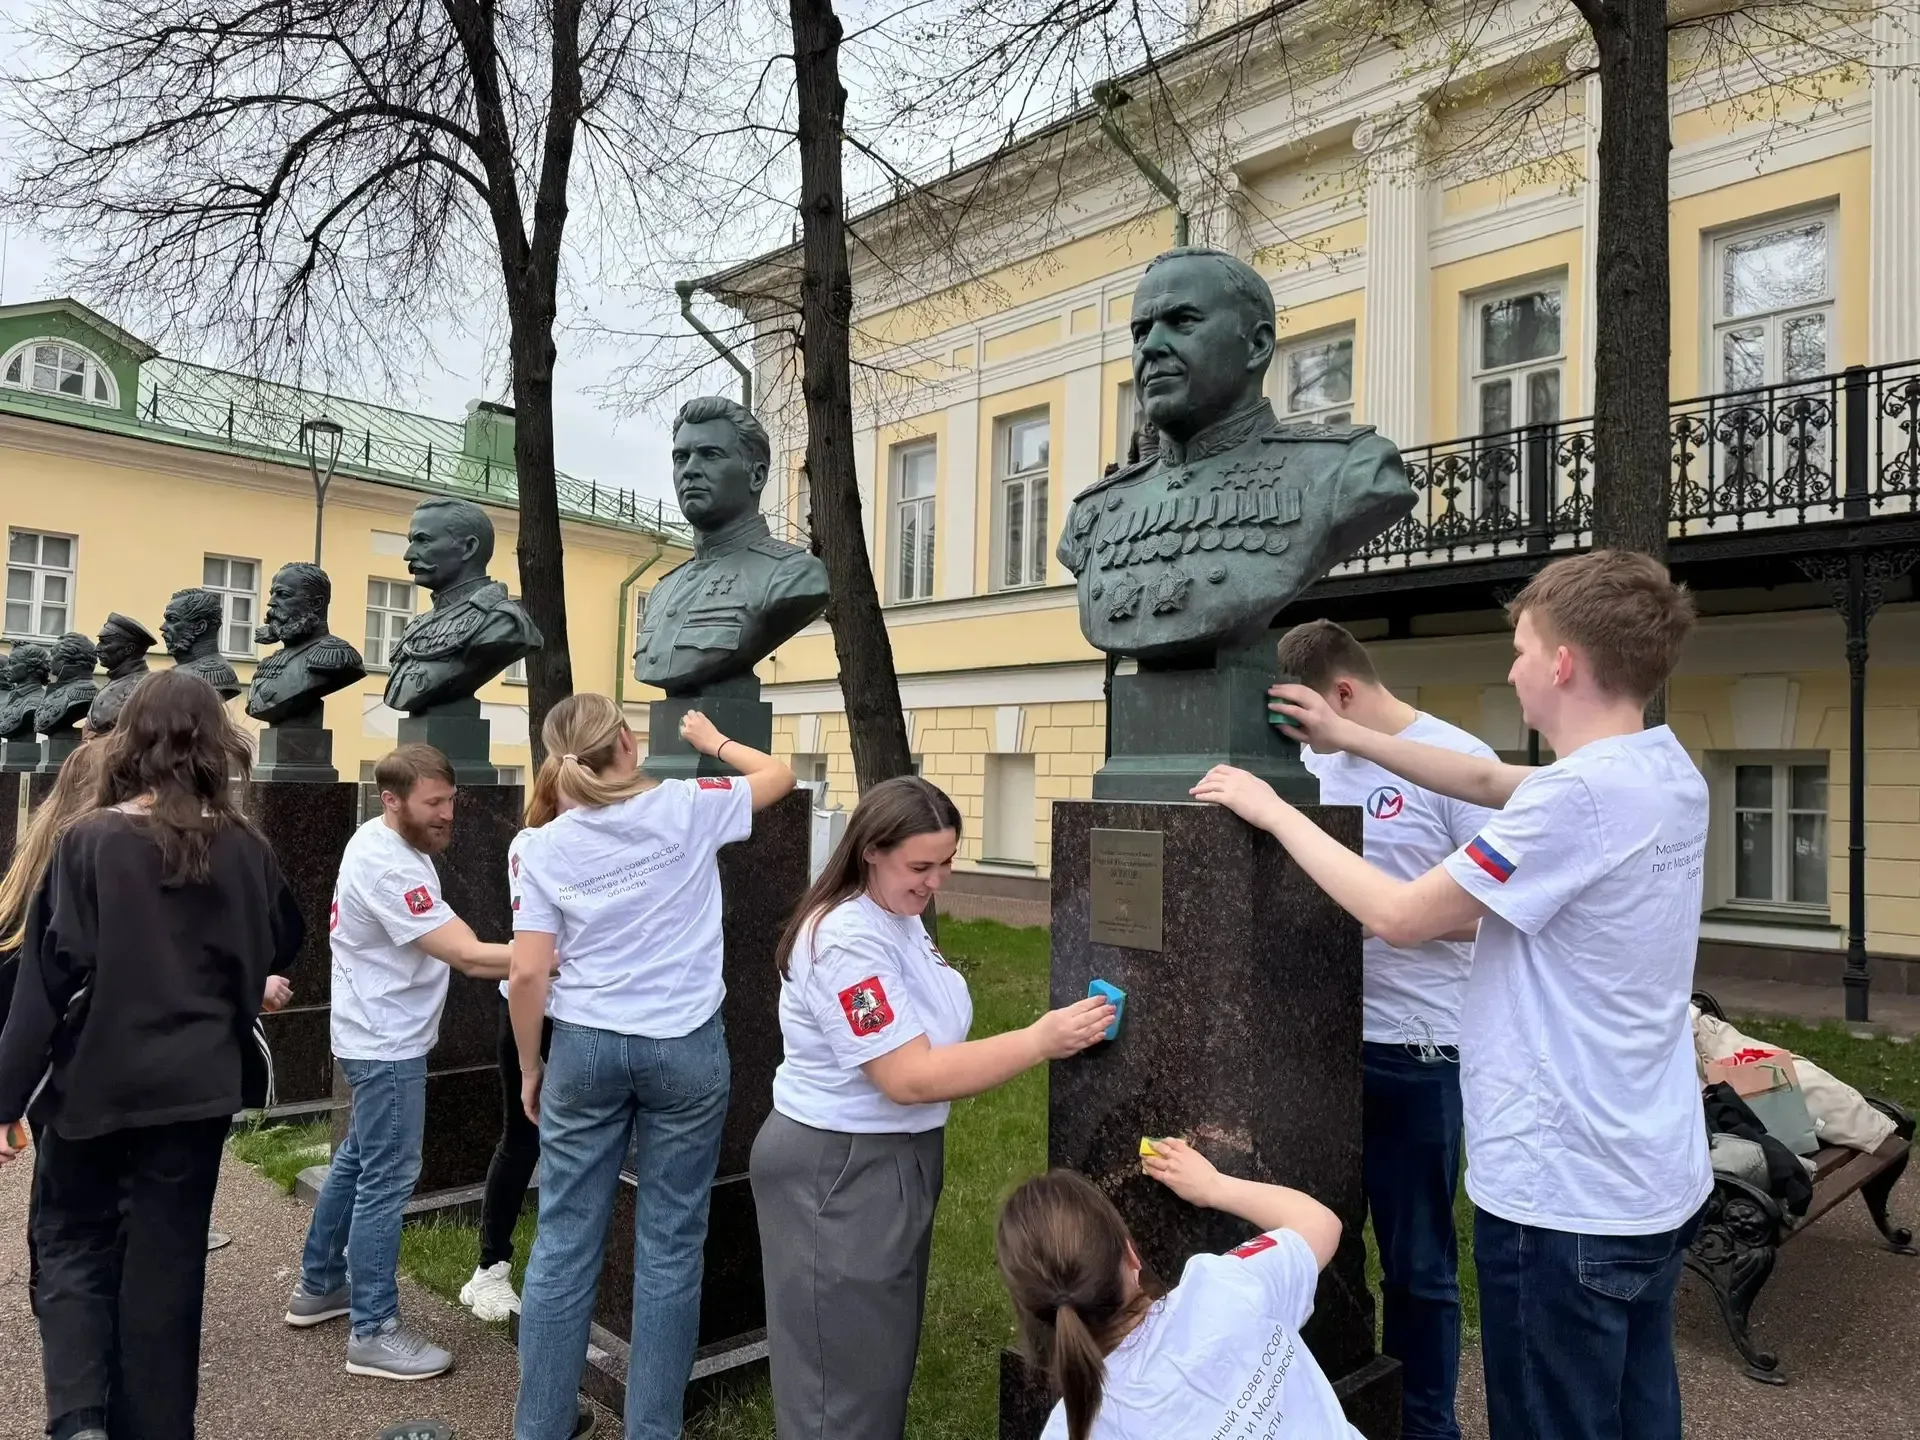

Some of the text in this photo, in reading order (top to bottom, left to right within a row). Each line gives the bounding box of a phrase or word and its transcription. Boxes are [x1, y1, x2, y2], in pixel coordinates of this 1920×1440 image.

[559, 843, 680, 893] Молодежный совет ОСФР
[582, 880, 618, 896] Москве
[629, 851, 686, 881] Московской
[1652, 863, 1665, 872] по
[607, 879, 647, 898] области
[1236, 1367, 1266, 1409] совет
[1262, 1324, 1283, 1366] ОСФР
[1244, 1421, 1257, 1434] и
